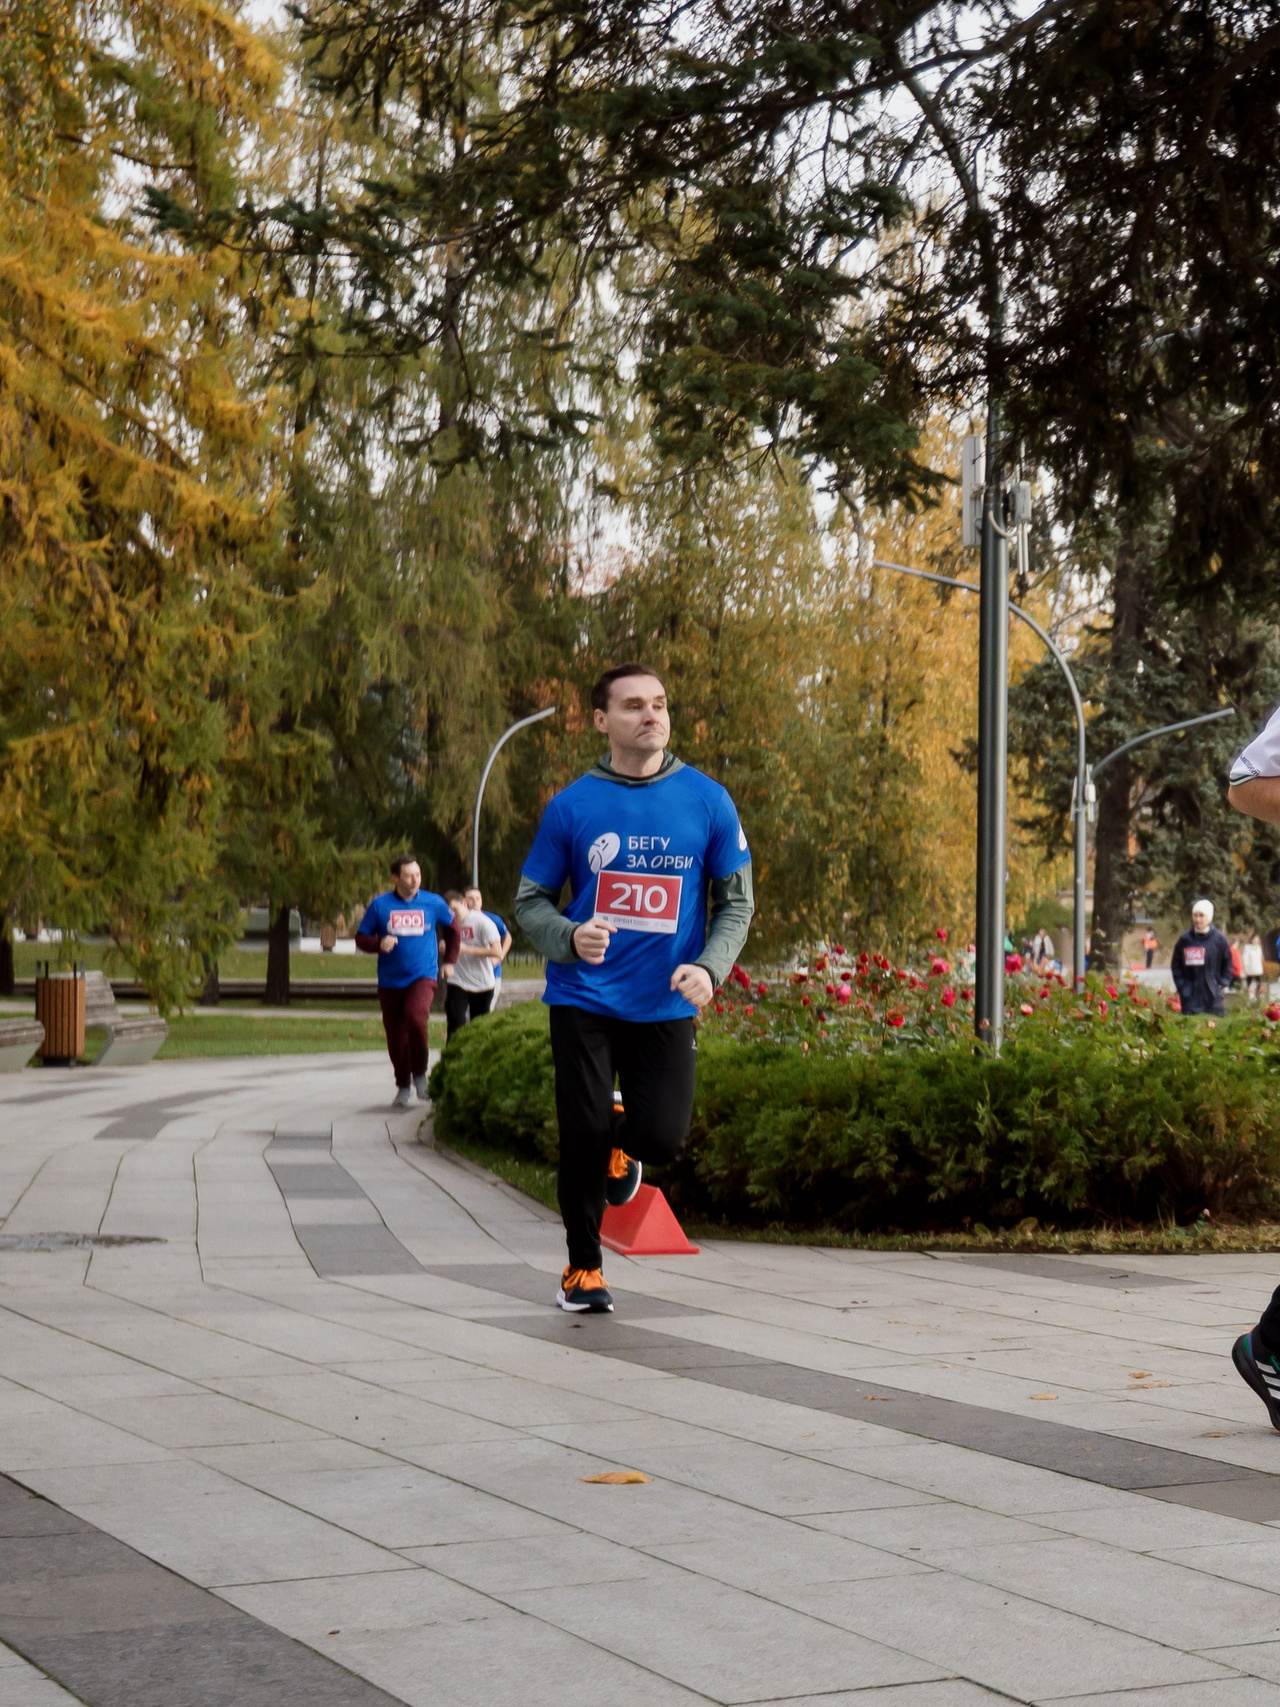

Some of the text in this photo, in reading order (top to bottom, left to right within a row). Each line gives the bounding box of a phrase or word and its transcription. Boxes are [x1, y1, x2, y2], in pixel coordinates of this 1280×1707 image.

[628, 835, 671, 851] БЕГУ
[626, 854, 694, 870] ЗА ОРБИ
[609, 882, 668, 914] 210
[394, 914, 421, 928] 200
